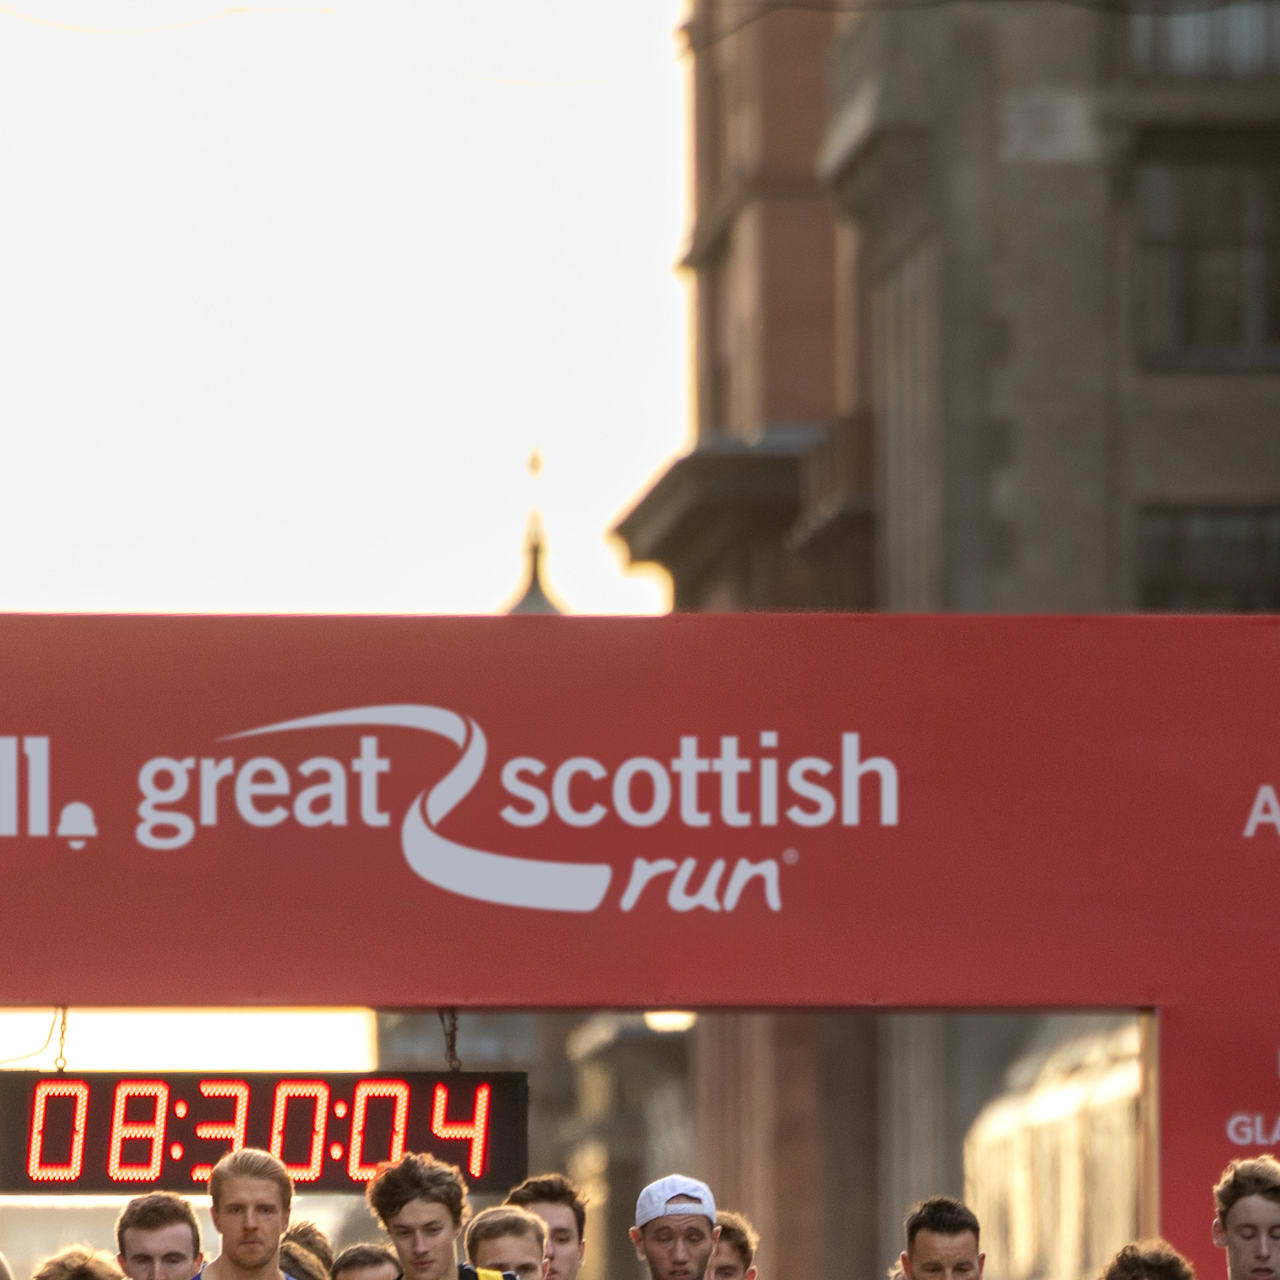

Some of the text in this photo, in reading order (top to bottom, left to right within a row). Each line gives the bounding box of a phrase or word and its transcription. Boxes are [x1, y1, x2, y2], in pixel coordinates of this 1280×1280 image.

[135, 731, 899, 850] great scottish
[619, 857, 782, 912] run
[26, 1078, 492, 1182] 08:30:04
